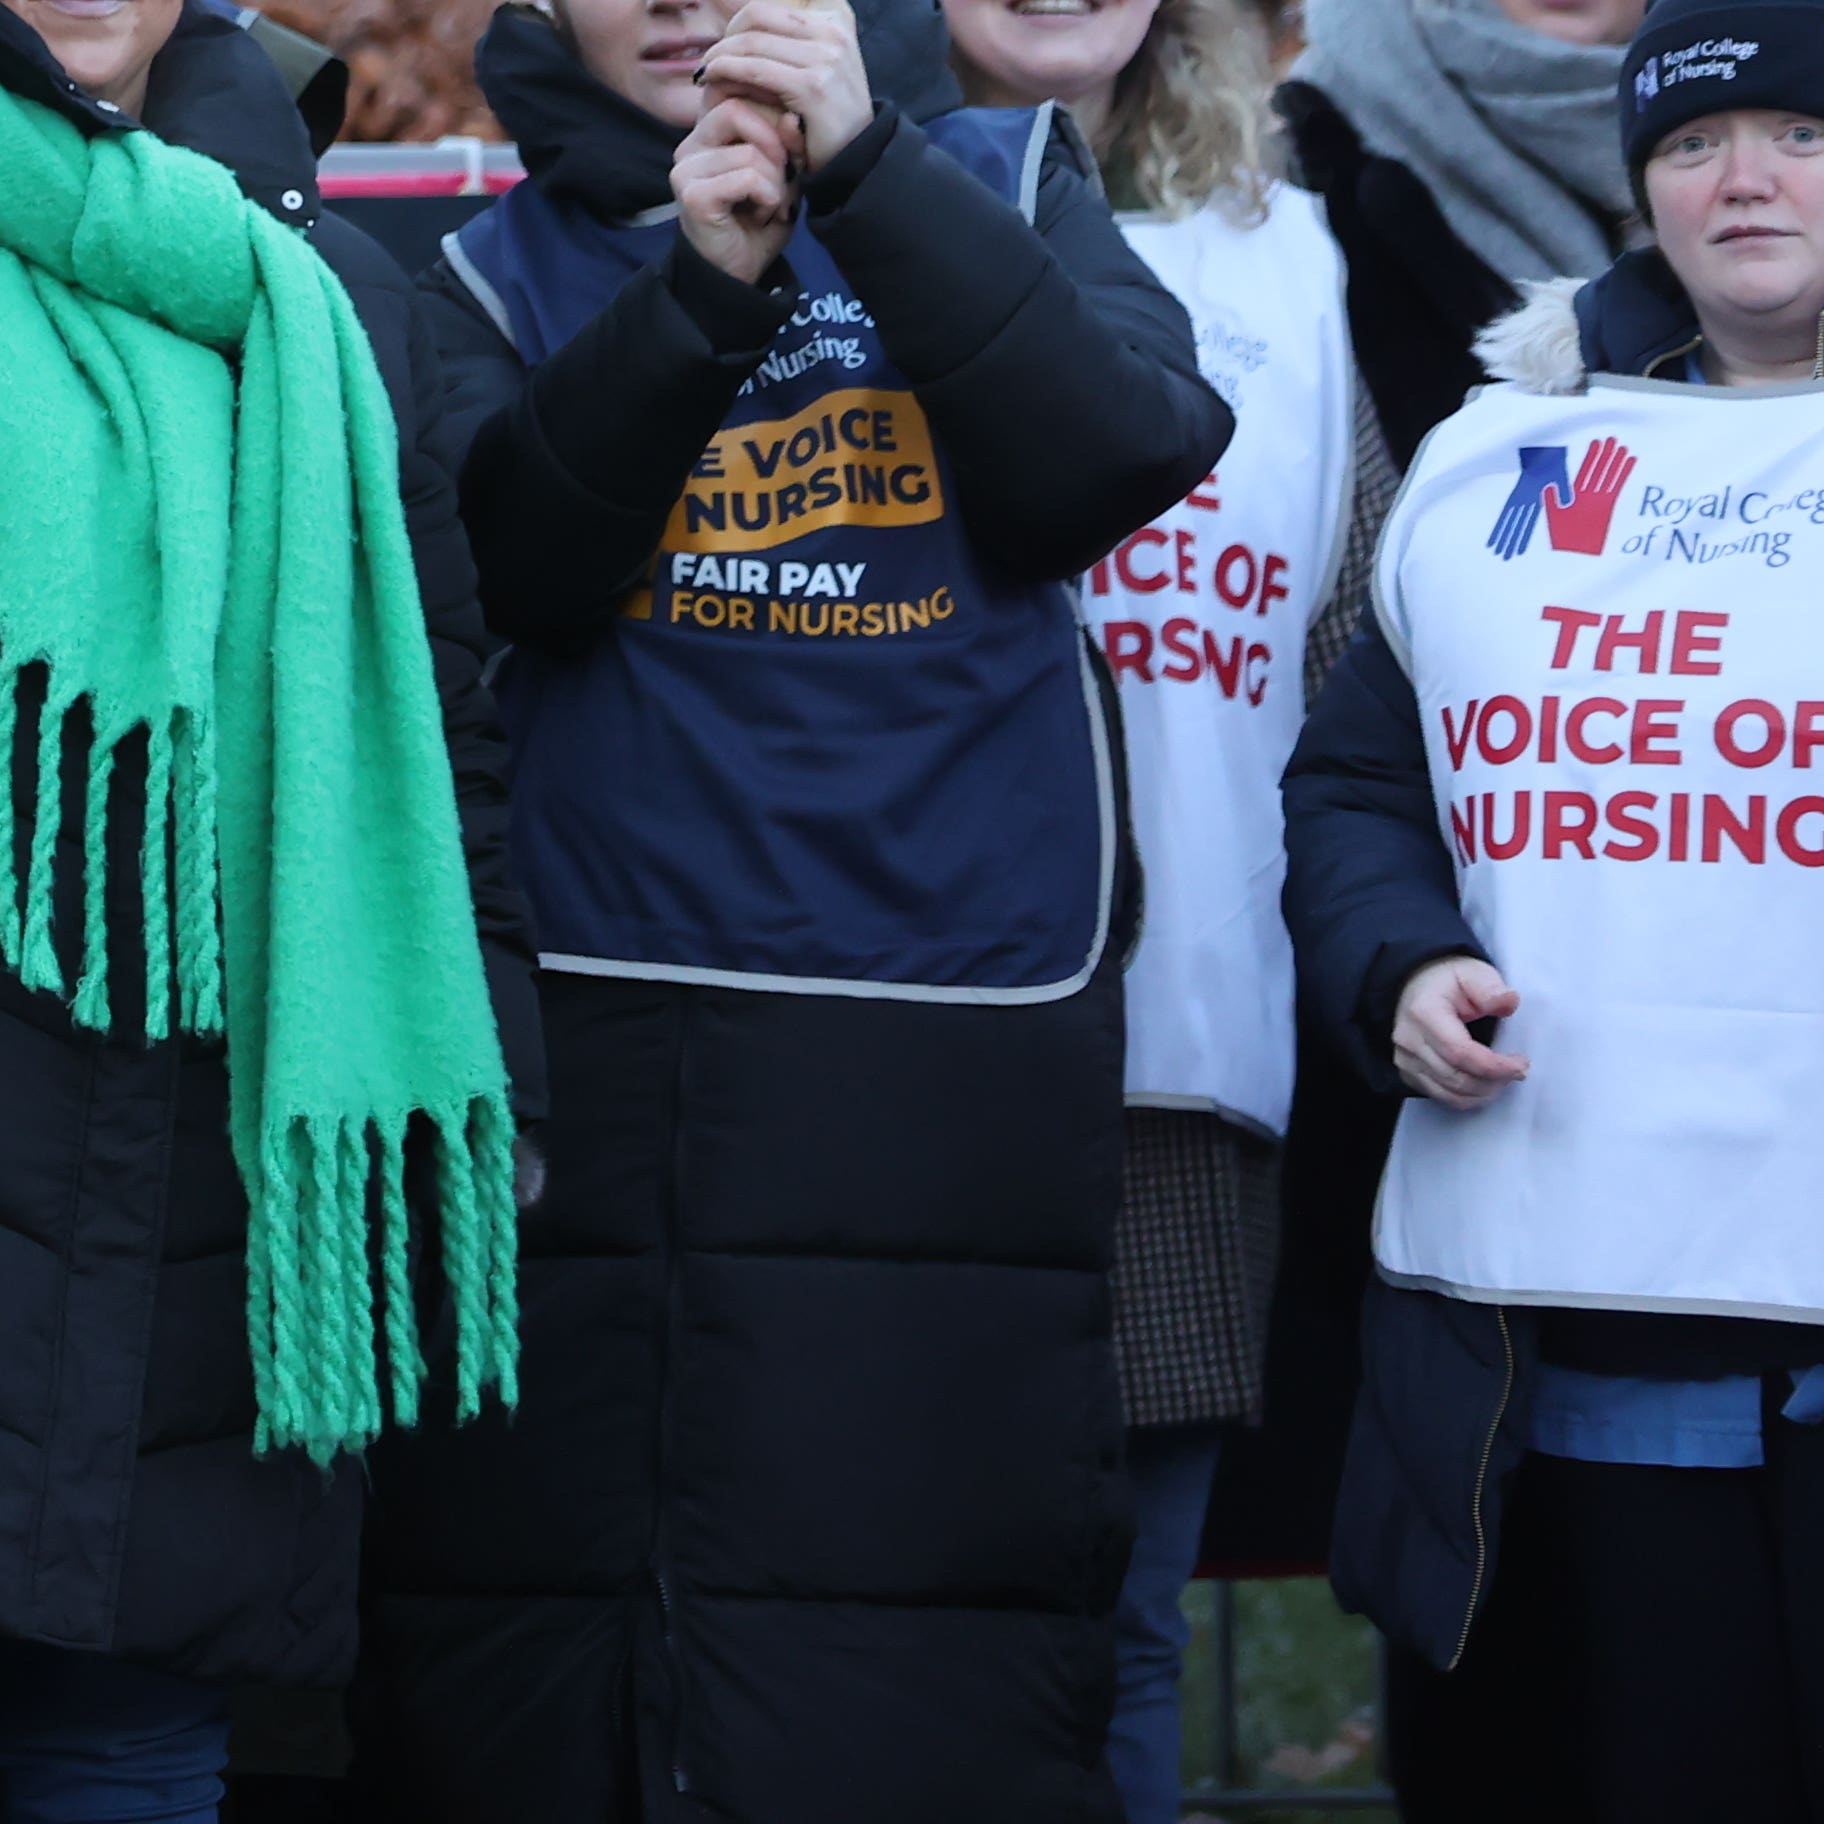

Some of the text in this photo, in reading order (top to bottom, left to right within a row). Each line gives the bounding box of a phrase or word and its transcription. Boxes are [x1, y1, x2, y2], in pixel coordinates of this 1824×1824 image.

[1700, 36, 1760, 61] College
[756, 329, 867, 389] Nursing
[743, 409, 898, 480] VOICE
[685, 464, 931, 535] NURSING
[1638, 485, 1731, 525] Royal
[1621, 525, 1663, 556] of
[671, 551, 868, 598] FAIR PAY
[1214, 543, 1290, 618] OF
[670, 585, 955, 638] FOR NURSING
[1541, 605, 1730, 676] THE
[1441, 695, 1686, 773] VOICE
